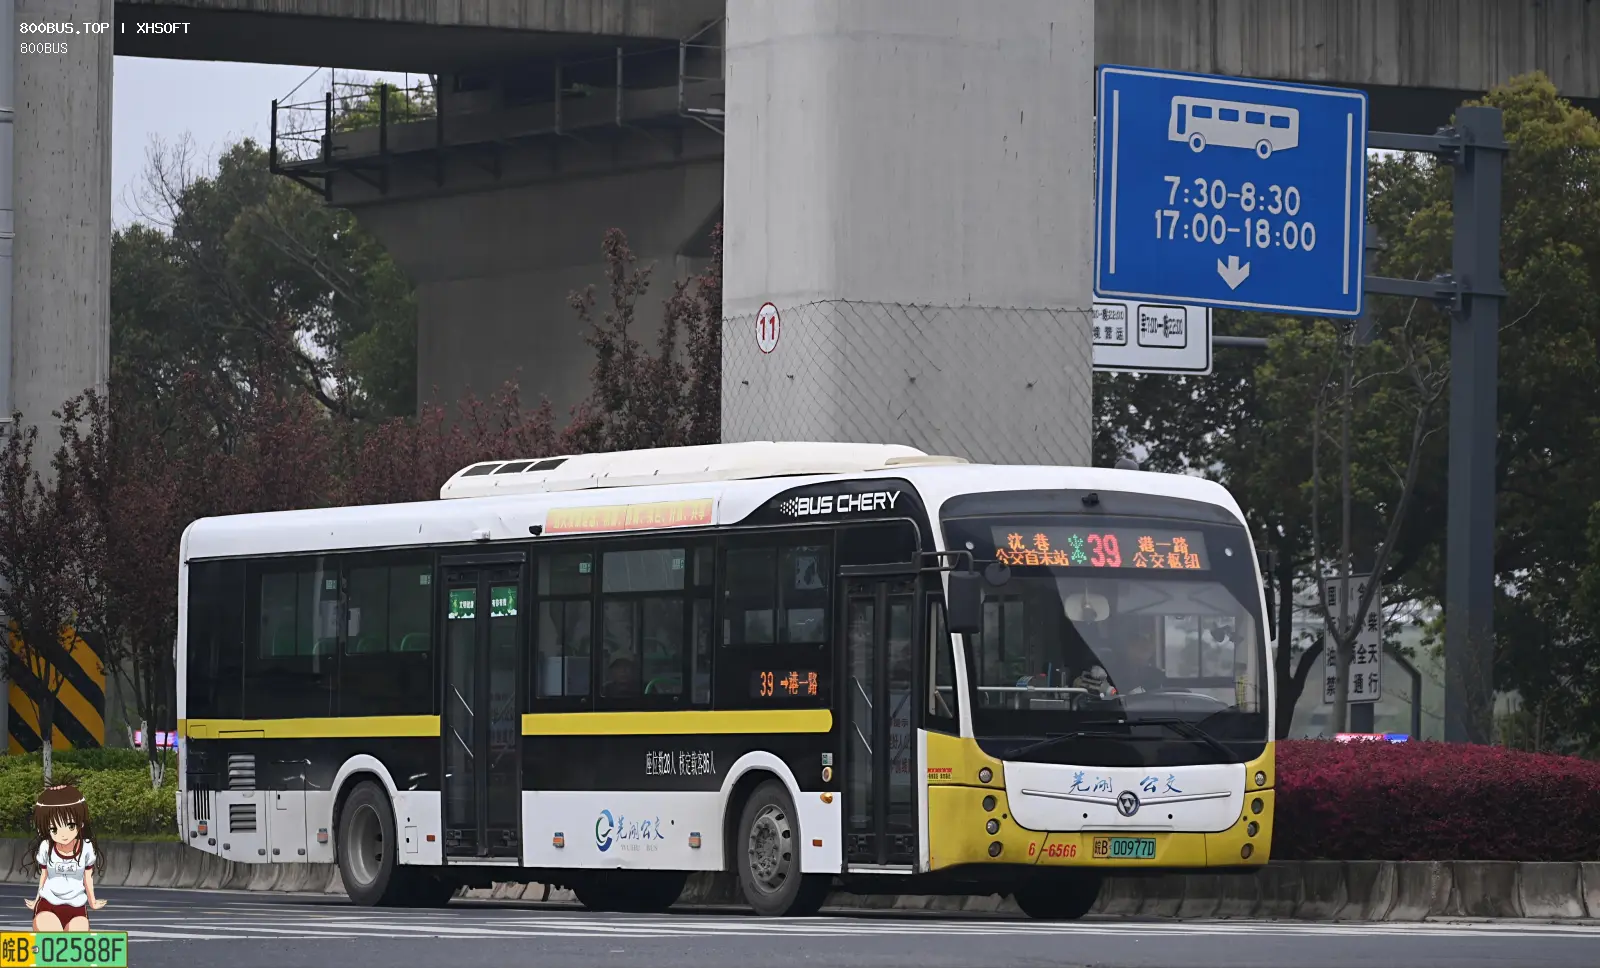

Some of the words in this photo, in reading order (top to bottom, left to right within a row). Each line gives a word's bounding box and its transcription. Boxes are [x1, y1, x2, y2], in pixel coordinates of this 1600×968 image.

[1164, 176, 1301, 216] 7:30-8:30
[1154, 210, 1316, 251] 17:00-18:00
[759, 316, 775, 341] 11
[797, 495, 834, 515] BUS
[837, 490, 901, 513] CHERY
[995, 549, 1069, 566] 公交首末站
[1087, 534, 1122, 568] 39
[1138, 536, 1189, 556] 港一路
[1132, 552, 1201, 569] 公交枢纽
[760, 671, 774, 697] 39
[789, 671, 818, 695] 港一路
[1139, 774, 1183, 793] 公交
